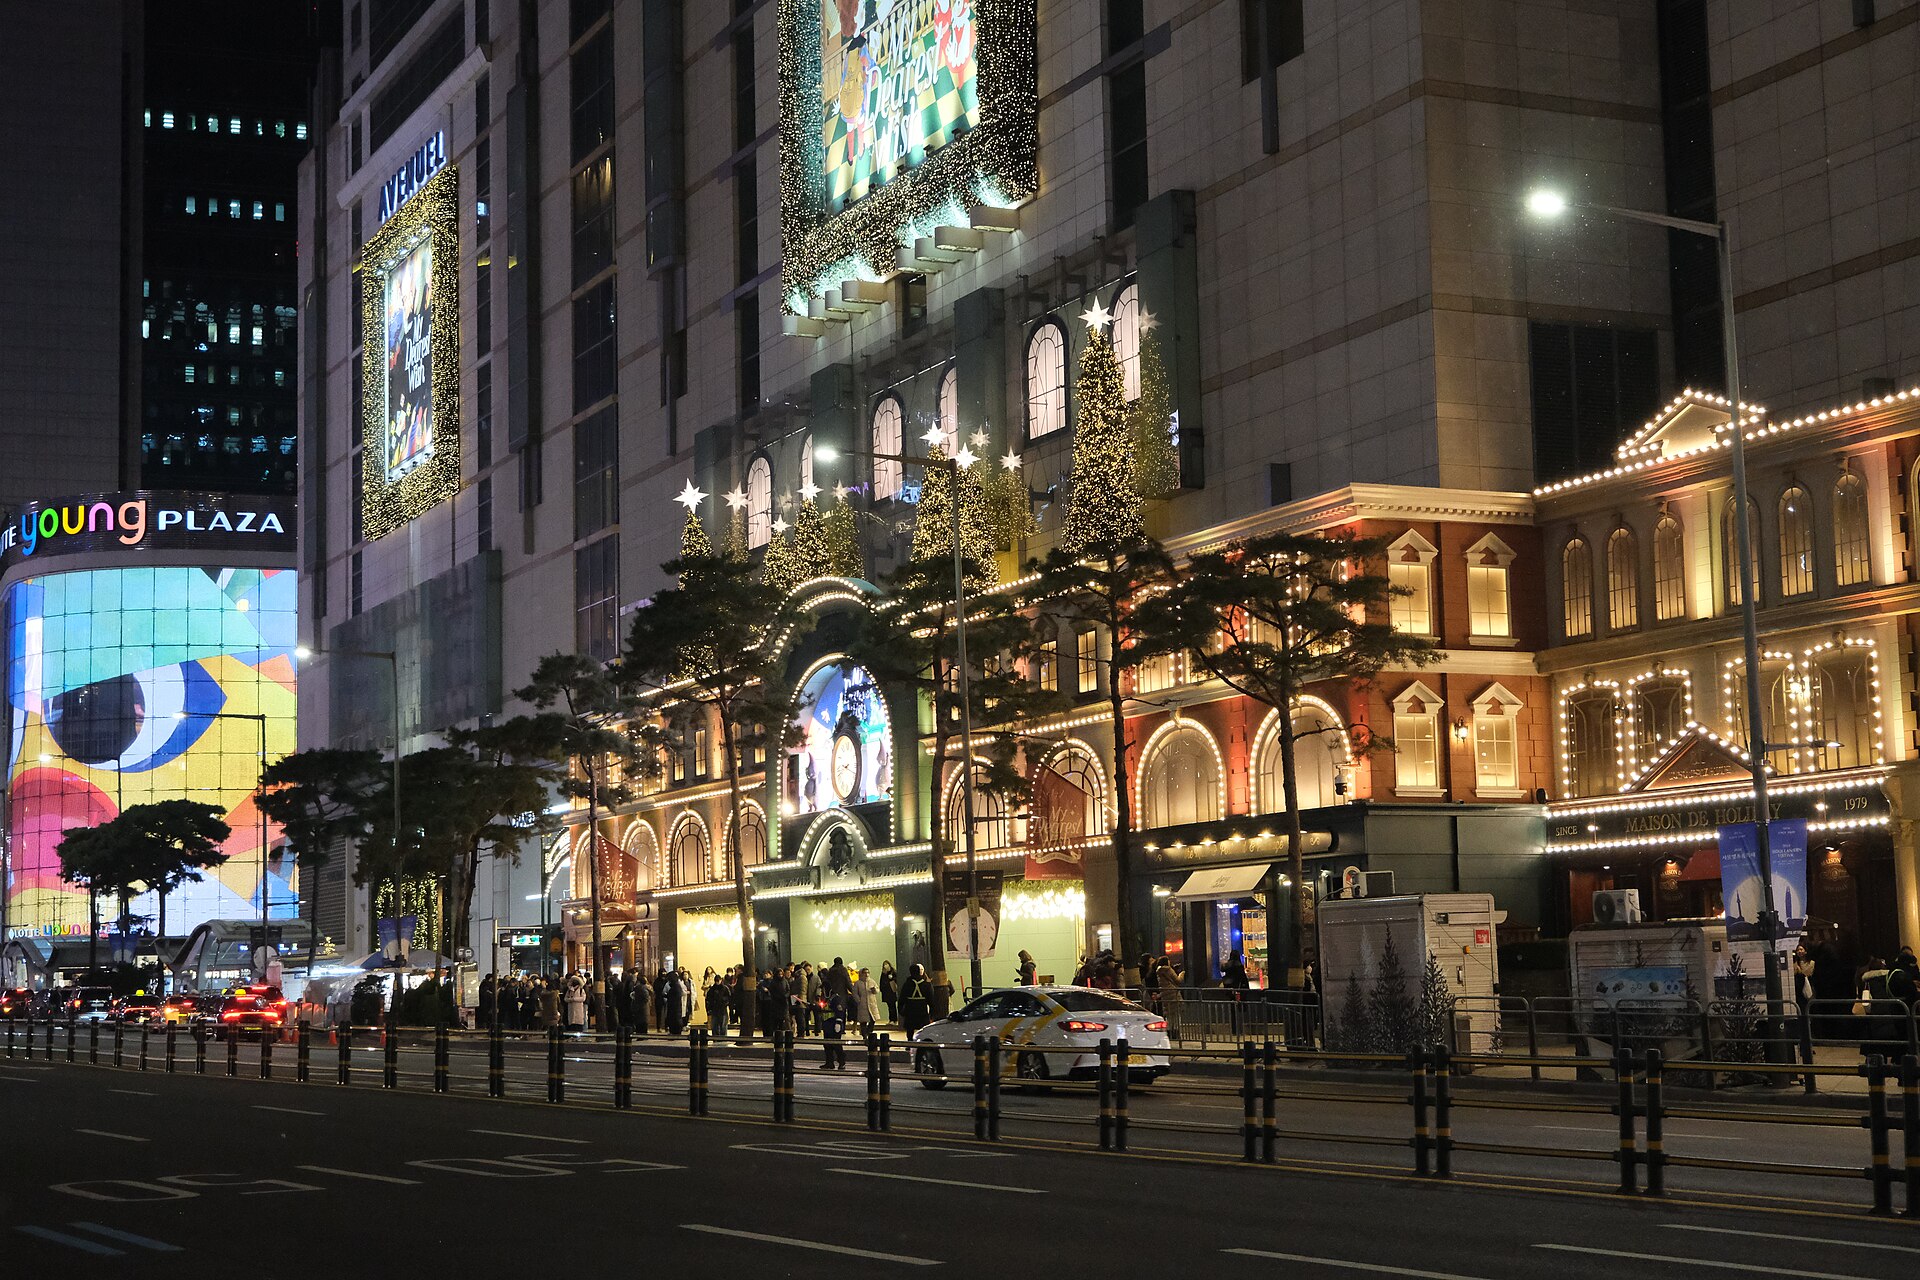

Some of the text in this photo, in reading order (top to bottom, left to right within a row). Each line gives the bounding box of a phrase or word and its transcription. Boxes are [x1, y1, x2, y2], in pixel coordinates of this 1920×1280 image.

[863, 40, 942, 131] Dearest
[872, 96, 924, 174] Wish
[378, 129, 446, 224] AVENUEL
[404, 324, 432, 372] Dearest
[408, 360, 426, 393] Wish
[20, 499, 147, 557] young
[158, 509, 285, 533] PLAZA
[1032, 816, 1083, 834] Dearest
[1555, 825, 1578, 837] SINCE
[1626, 812, 1682, 833] MAISON
[1687, 810, 1709, 827] DE
[1844, 796, 1868, 811] 1979
[14, 928, 41, 939] LOTTE
